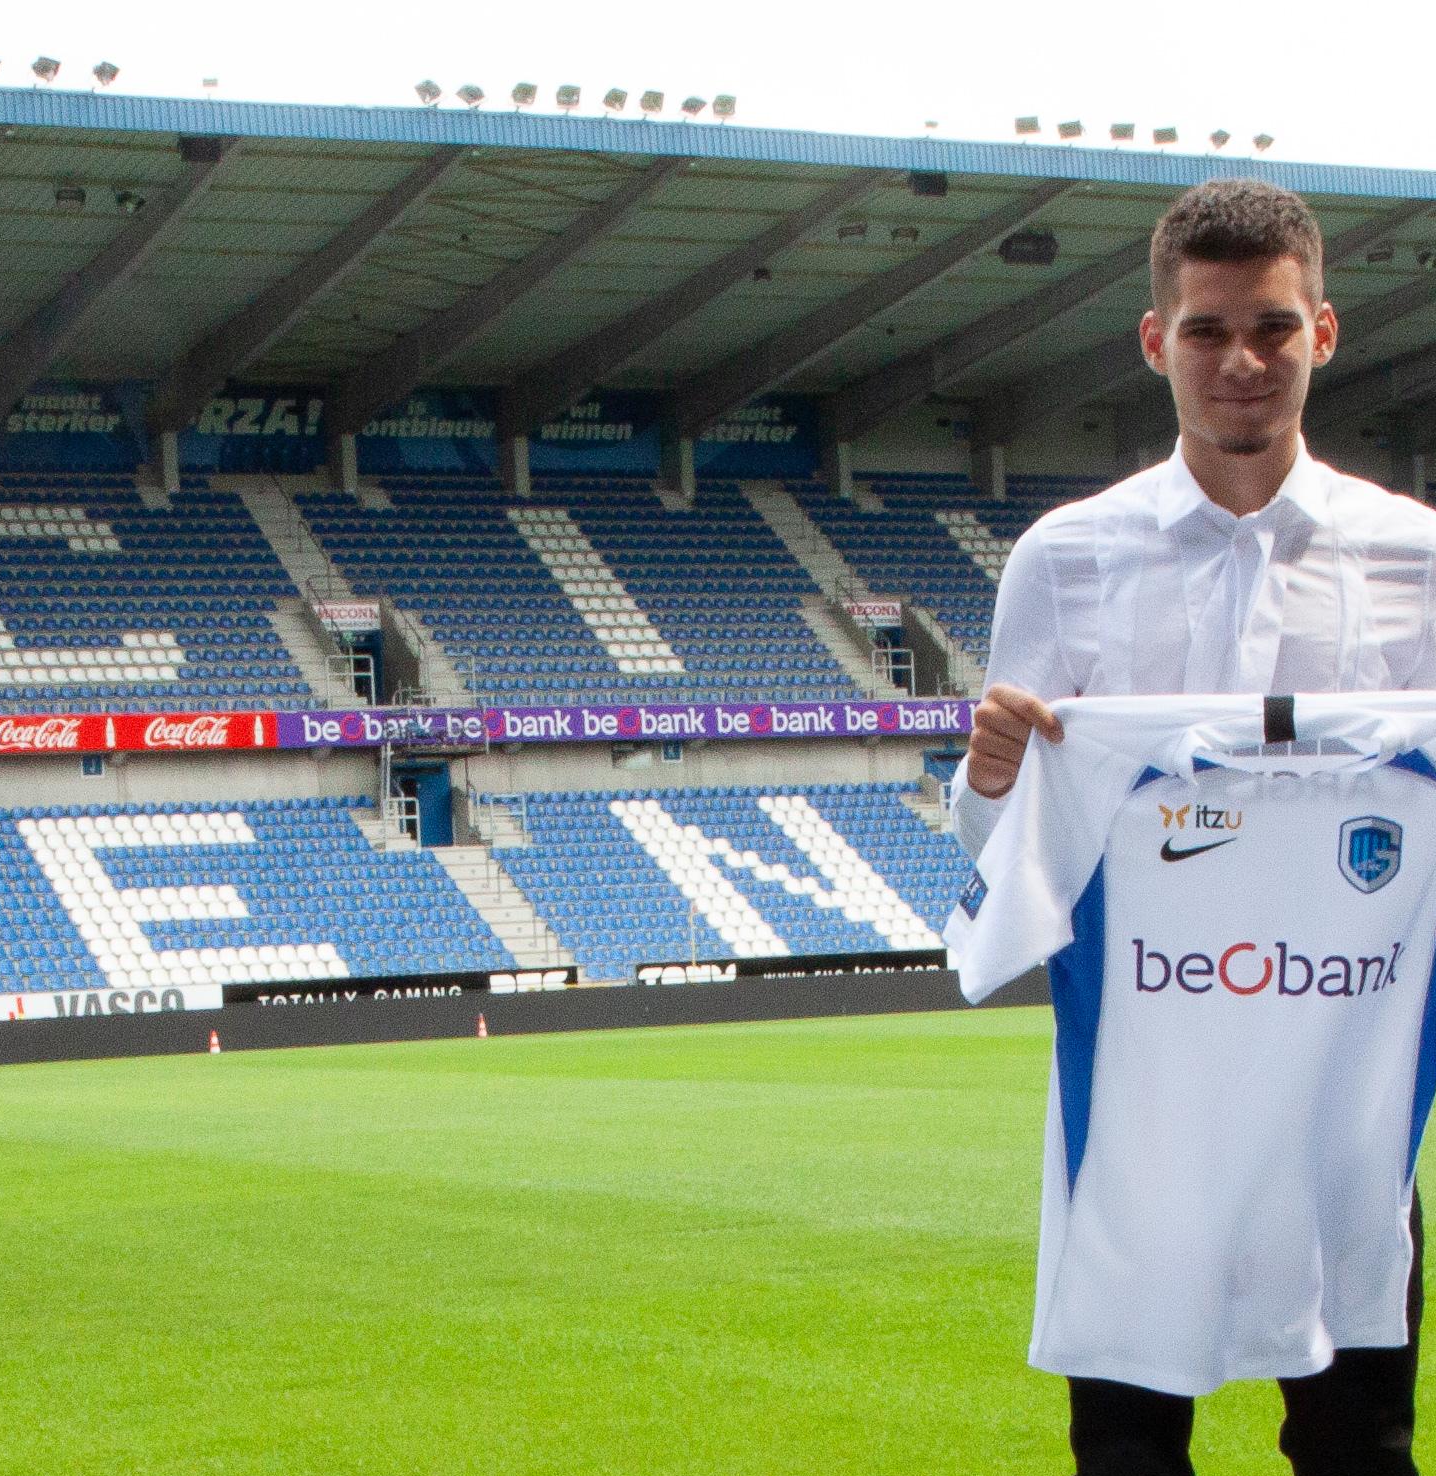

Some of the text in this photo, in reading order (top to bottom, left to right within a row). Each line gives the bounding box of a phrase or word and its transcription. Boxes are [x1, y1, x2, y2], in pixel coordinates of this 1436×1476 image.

[6, 410, 121, 433] sterker
[540, 419, 634, 441] winnen
[144, 716, 232, 748] Coca-Cola
